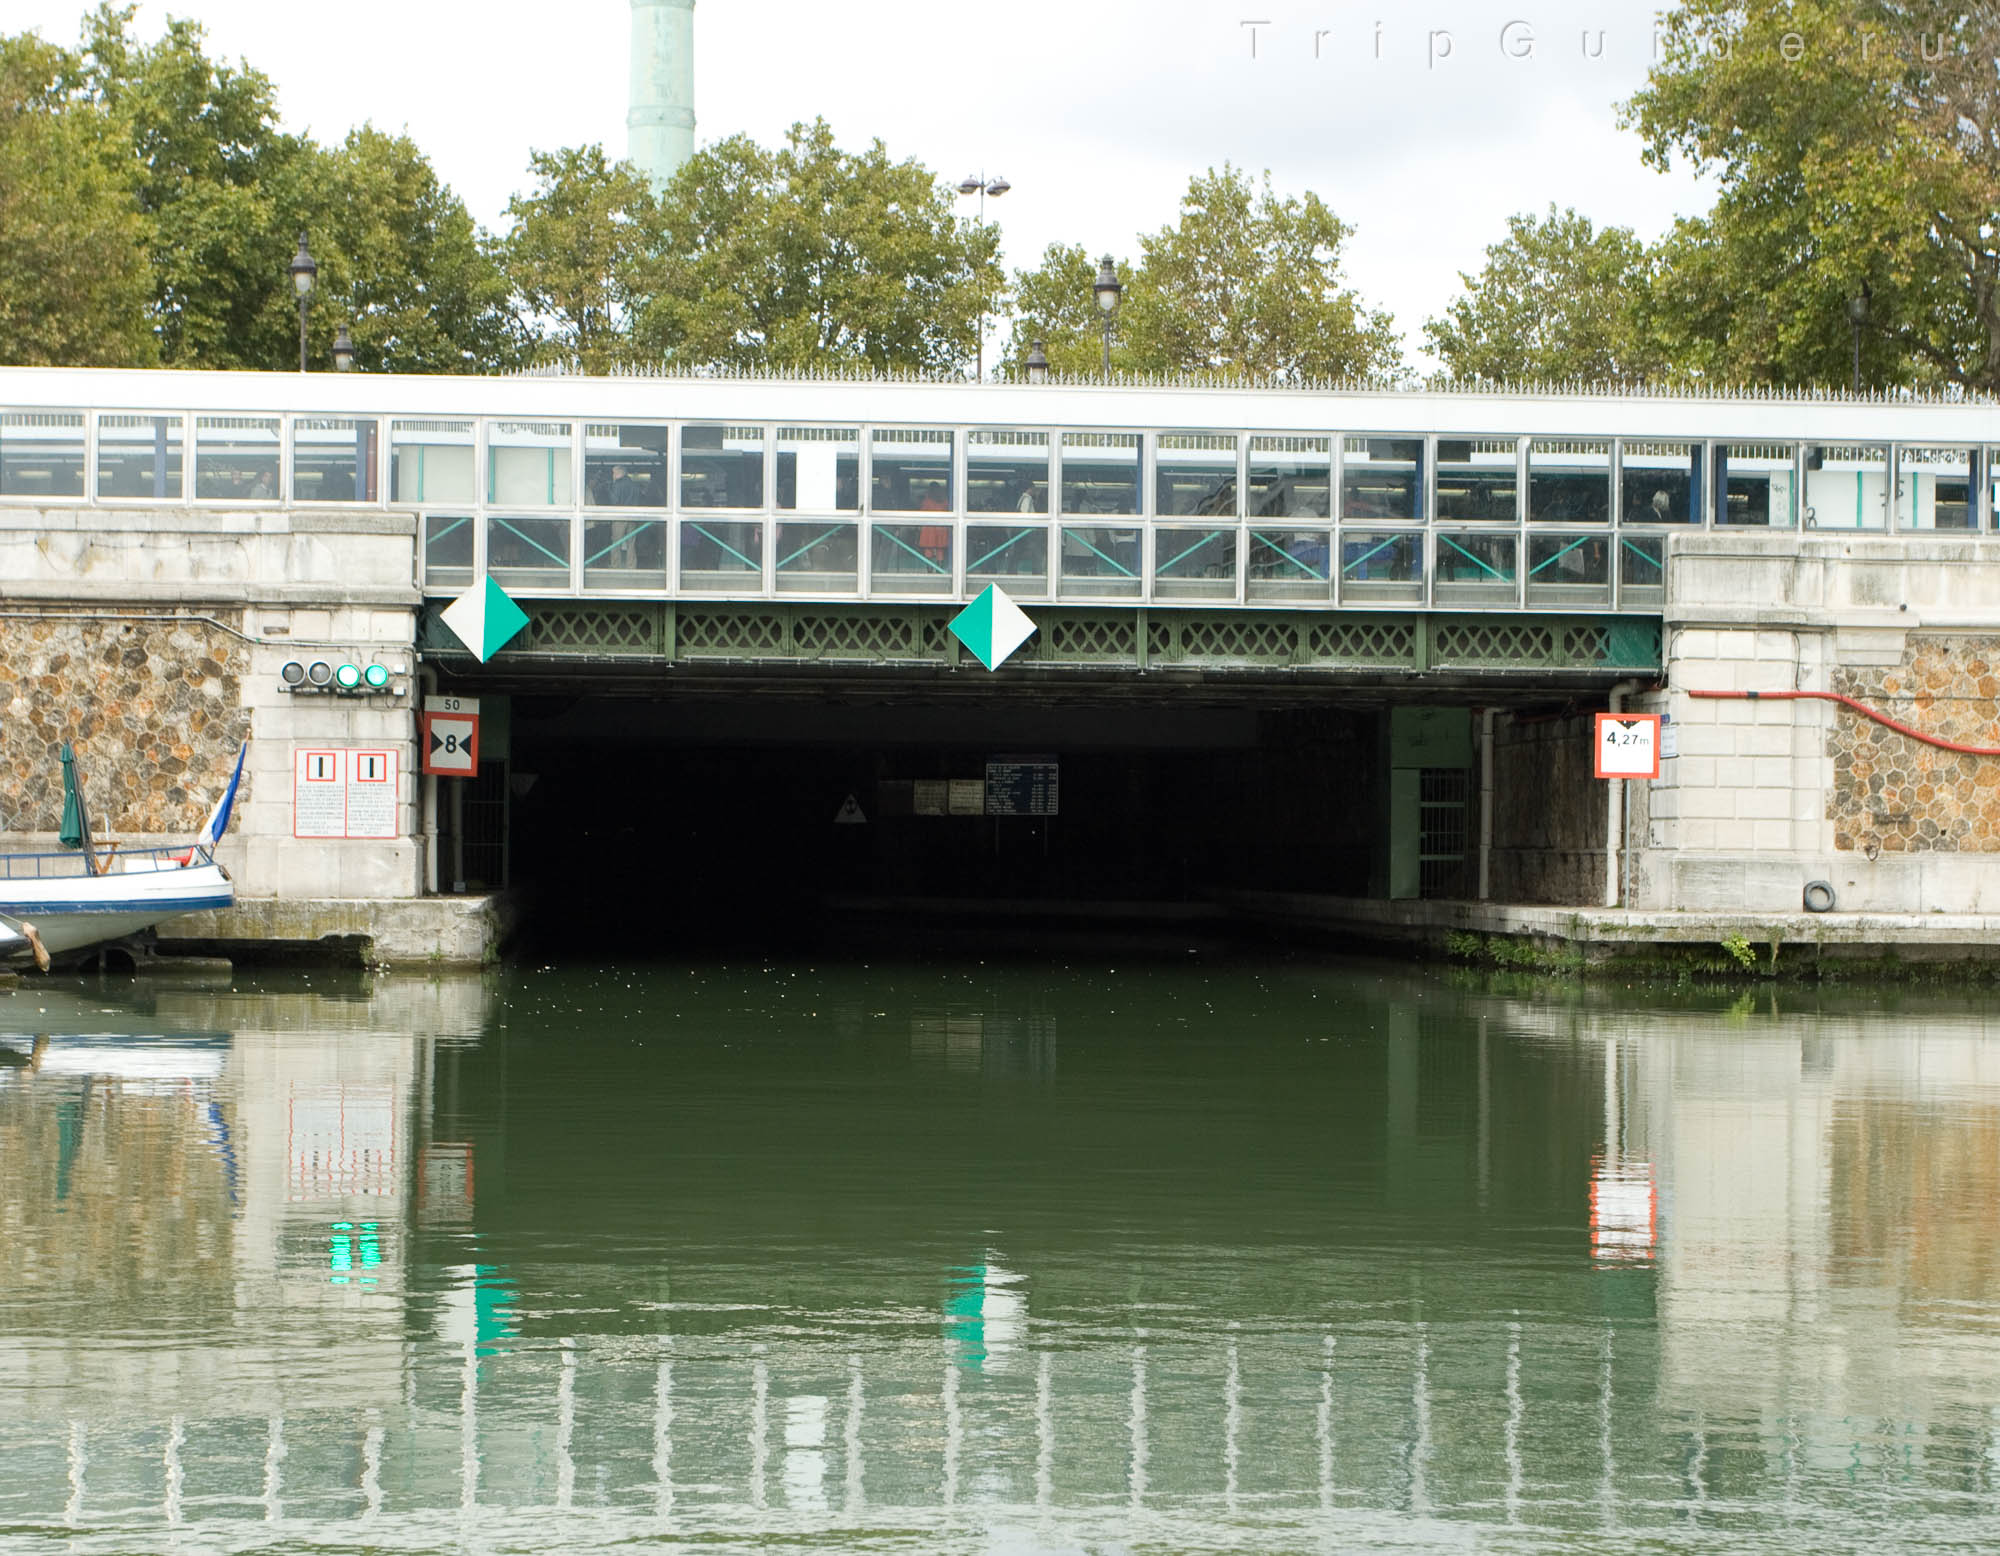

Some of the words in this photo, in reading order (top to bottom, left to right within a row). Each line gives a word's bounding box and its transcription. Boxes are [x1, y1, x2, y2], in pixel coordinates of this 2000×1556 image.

[444, 698, 461, 711] 50
[445, 734, 457, 754] 8
[1606, 731, 1649, 748] 4,27m
